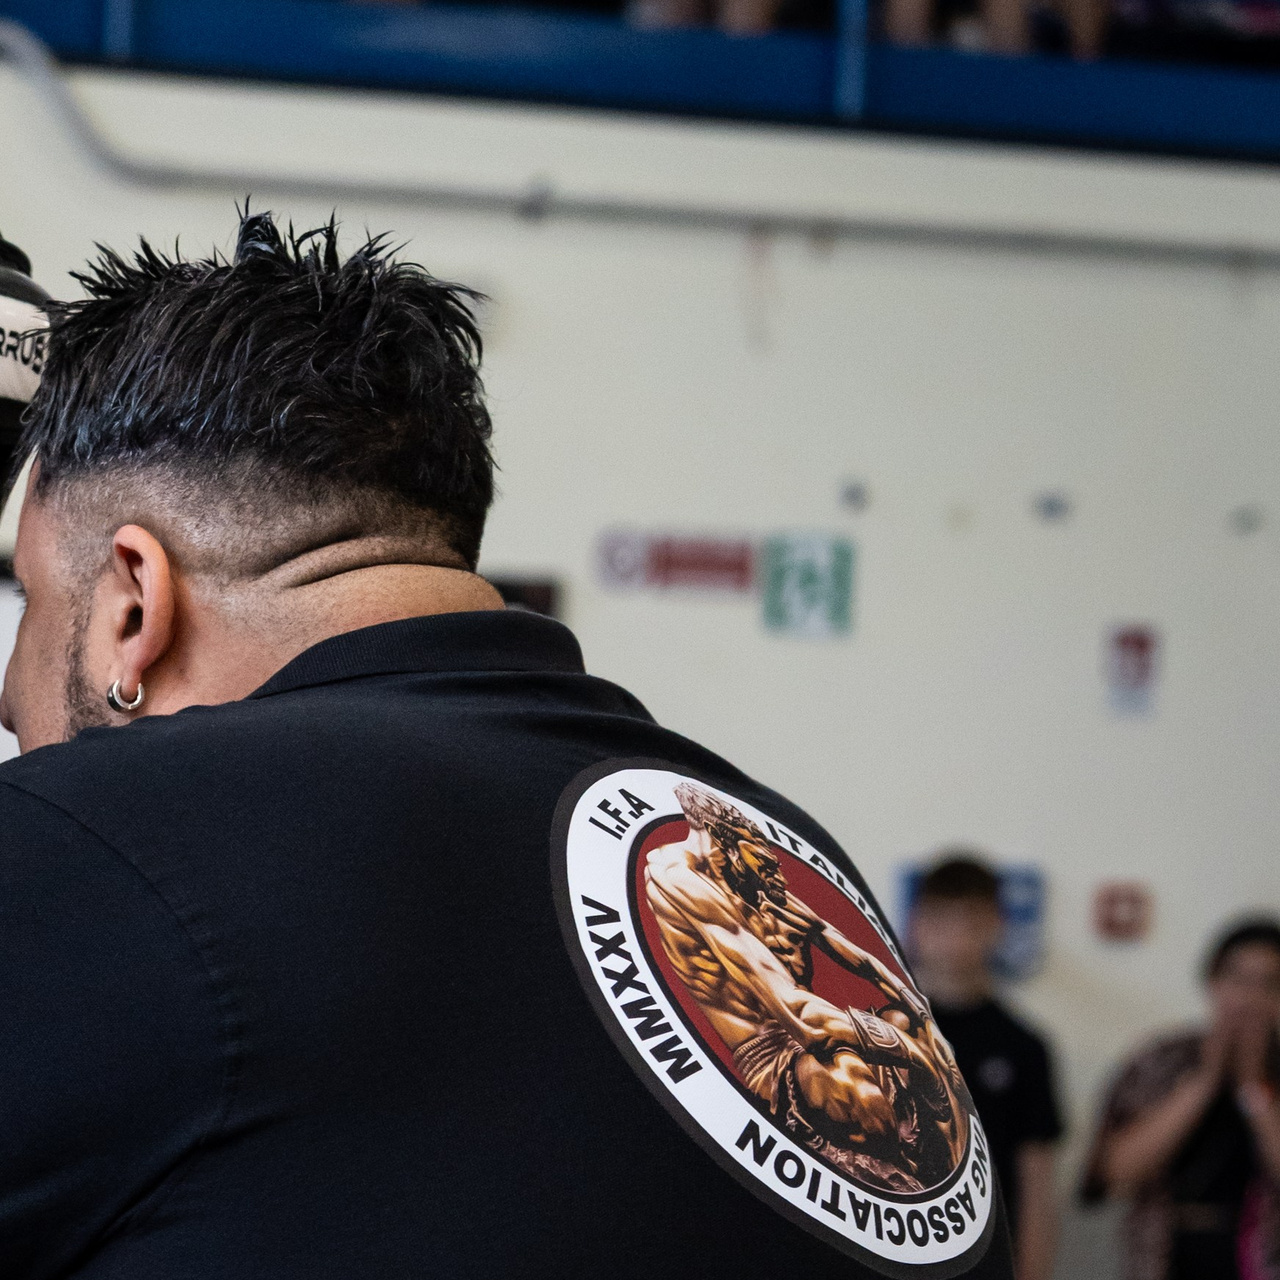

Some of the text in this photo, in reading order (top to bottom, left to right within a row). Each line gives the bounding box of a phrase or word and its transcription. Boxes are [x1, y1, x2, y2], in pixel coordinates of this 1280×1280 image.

[765, 821, 902, 962] ITALIA
[581, 895, 703, 1084] MMXXV
[735, 1118, 978, 1248] ASSOCIATION
